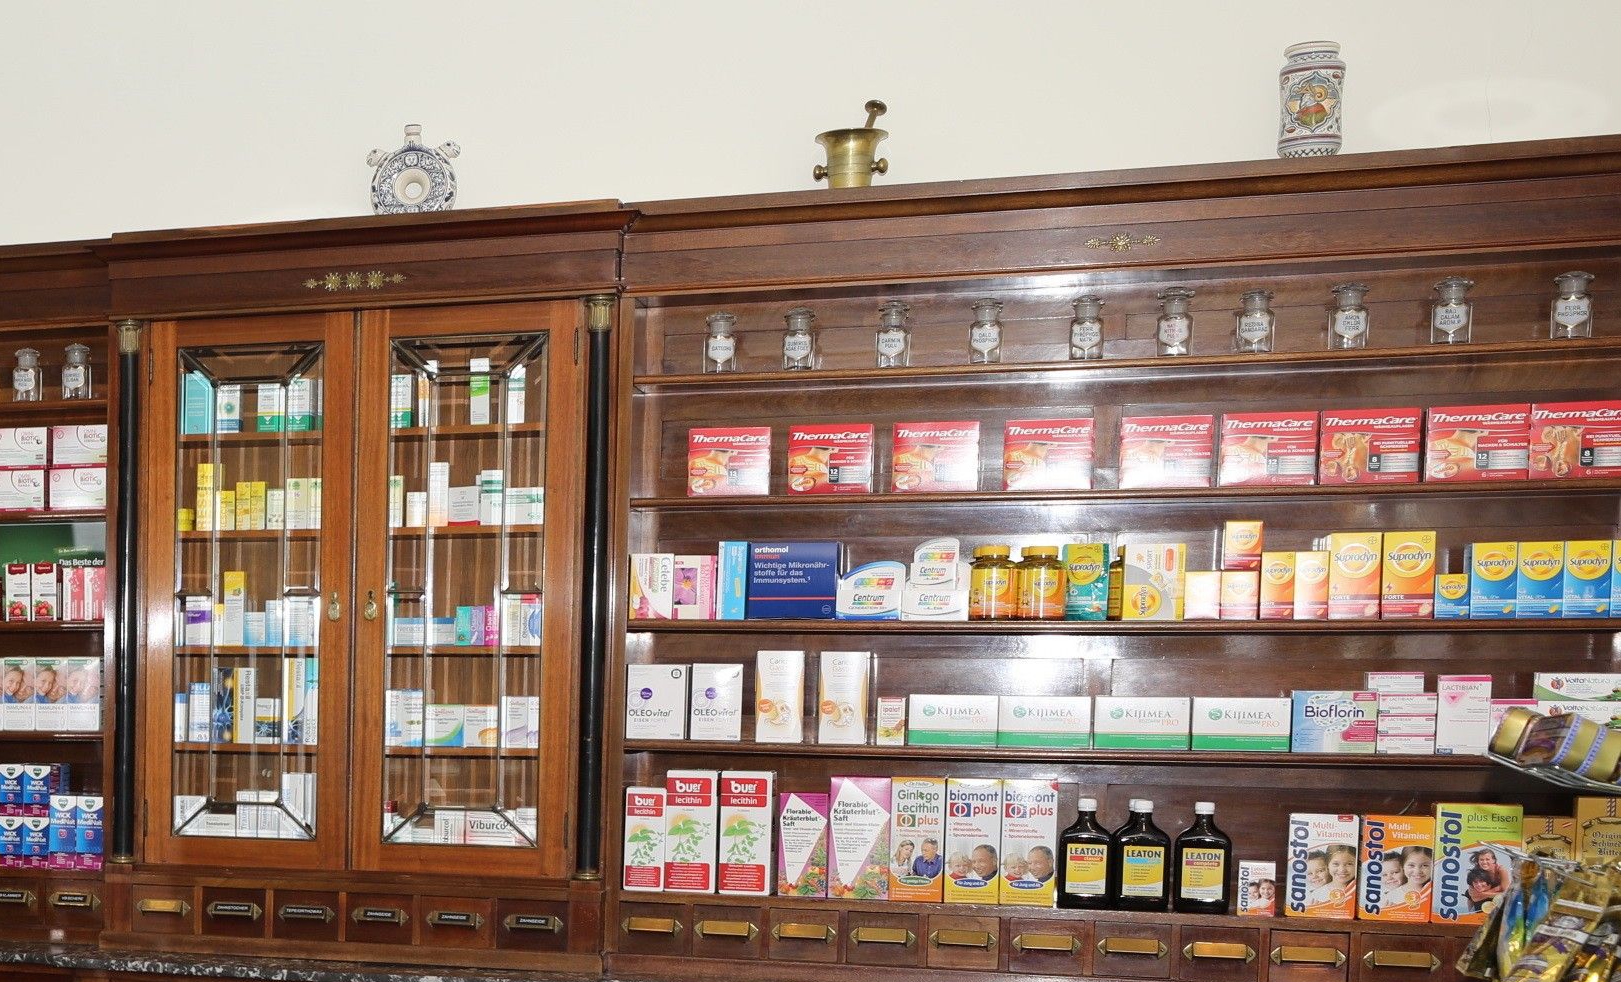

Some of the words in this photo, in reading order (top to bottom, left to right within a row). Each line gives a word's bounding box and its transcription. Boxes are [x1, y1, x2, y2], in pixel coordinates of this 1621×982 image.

[1325, 416, 1417, 427] ThermaCare
[1431, 412, 1527, 423] ThermaCare
[1124, 422, 1210, 433] ThermaCare
[1226, 419, 1314, 430] ThermaCare
[1008, 426, 1091, 436] ThermaCare
[692, 434, 767, 444] ThermaCare
[792, 431, 869, 442] ThermaCare
[1333, 552, 1378, 563] Supradyn
[1387, 551, 1431, 562] Supradyn
[58, 558, 71, 566] Das
[72, 558, 92, 566] Beste
[92, 558, 104, 566] der
[754, 562, 787, 571] Wichtige
[1477, 559, 1514, 568] Supradyn
[1522, 559, 1561, 568] Supradyn
[1569, 558, 1608, 567] Supradyn
[754, 569, 776, 577] stoffe
[777, 569, 788, 577] für
[789, 569, 803, 577] das
[919, 566, 946, 575] Centrum
[853, 593, 884, 603] Centrum
[918, 593, 950, 603] Centrum
[628, 708, 671, 718] OLEOvital
[1304, 705, 1365, 721] Bioflorin
[1261, 720, 1280, 728] PRO
[675, 780, 702, 793] buer
[730, 780, 758, 793] buer
[634, 796, 656, 806] buer
[675, 796, 702, 804] lecithin
[730, 796, 758, 805] lecithin
[897, 790, 940, 802] Ginkgo
[949, 790, 999, 802] biomont
[634, 808, 656, 816] lecithin
[897, 803, 939, 814] Lecithin
[973, 804, 998, 817] plus
[1029, 804, 1054, 818] plus
[917, 815, 939, 827] plus
[1466, 813, 1489, 825] plus
[1491, 813, 1519, 823] Eisen
[1312, 821, 1337, 831] Multi-
[1387, 822, 1413, 832] Multi-
[1316, 830, 1354, 840] Vitamine
[1391, 831, 1431, 840] Vitamine
[1069, 847, 1104, 856] LEATON
[1126, 850, 1161, 858] LEATON
[1185, 853, 1221, 861] LEATON
[1290, 819, 1310, 913] sanostol
[1365, 819, 1386, 915] sanostol
[1440, 811, 1463, 921] sanostol
[1240, 866, 1249, 913] sanostol
